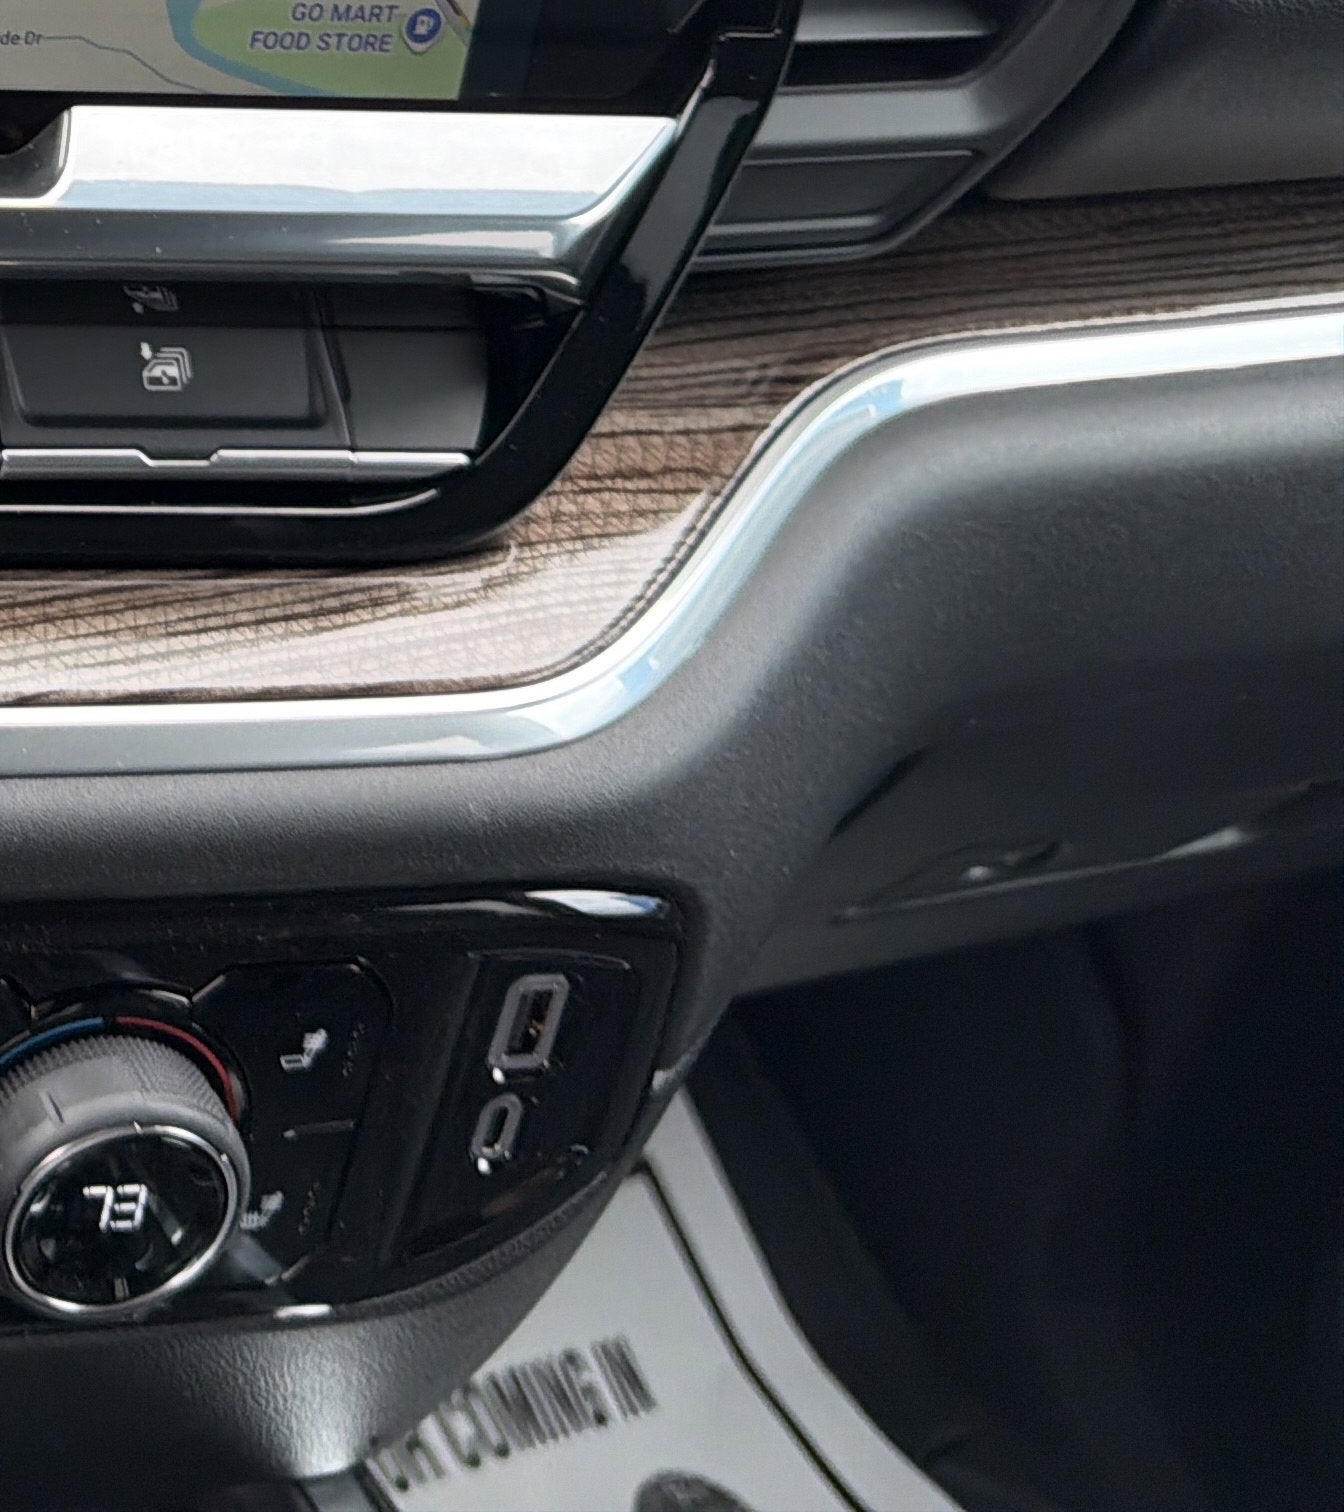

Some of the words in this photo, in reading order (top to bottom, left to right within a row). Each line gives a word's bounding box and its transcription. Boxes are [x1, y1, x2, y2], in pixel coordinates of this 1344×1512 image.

[291, 2, 324, 23] GO
[330, 4, 400, 25] MART
[24, 31, 43, 47] Dr
[249, 30, 311, 52] FOOD
[316, 31, 394, 54] STORE
[83, 1183, 148, 1231] 73
